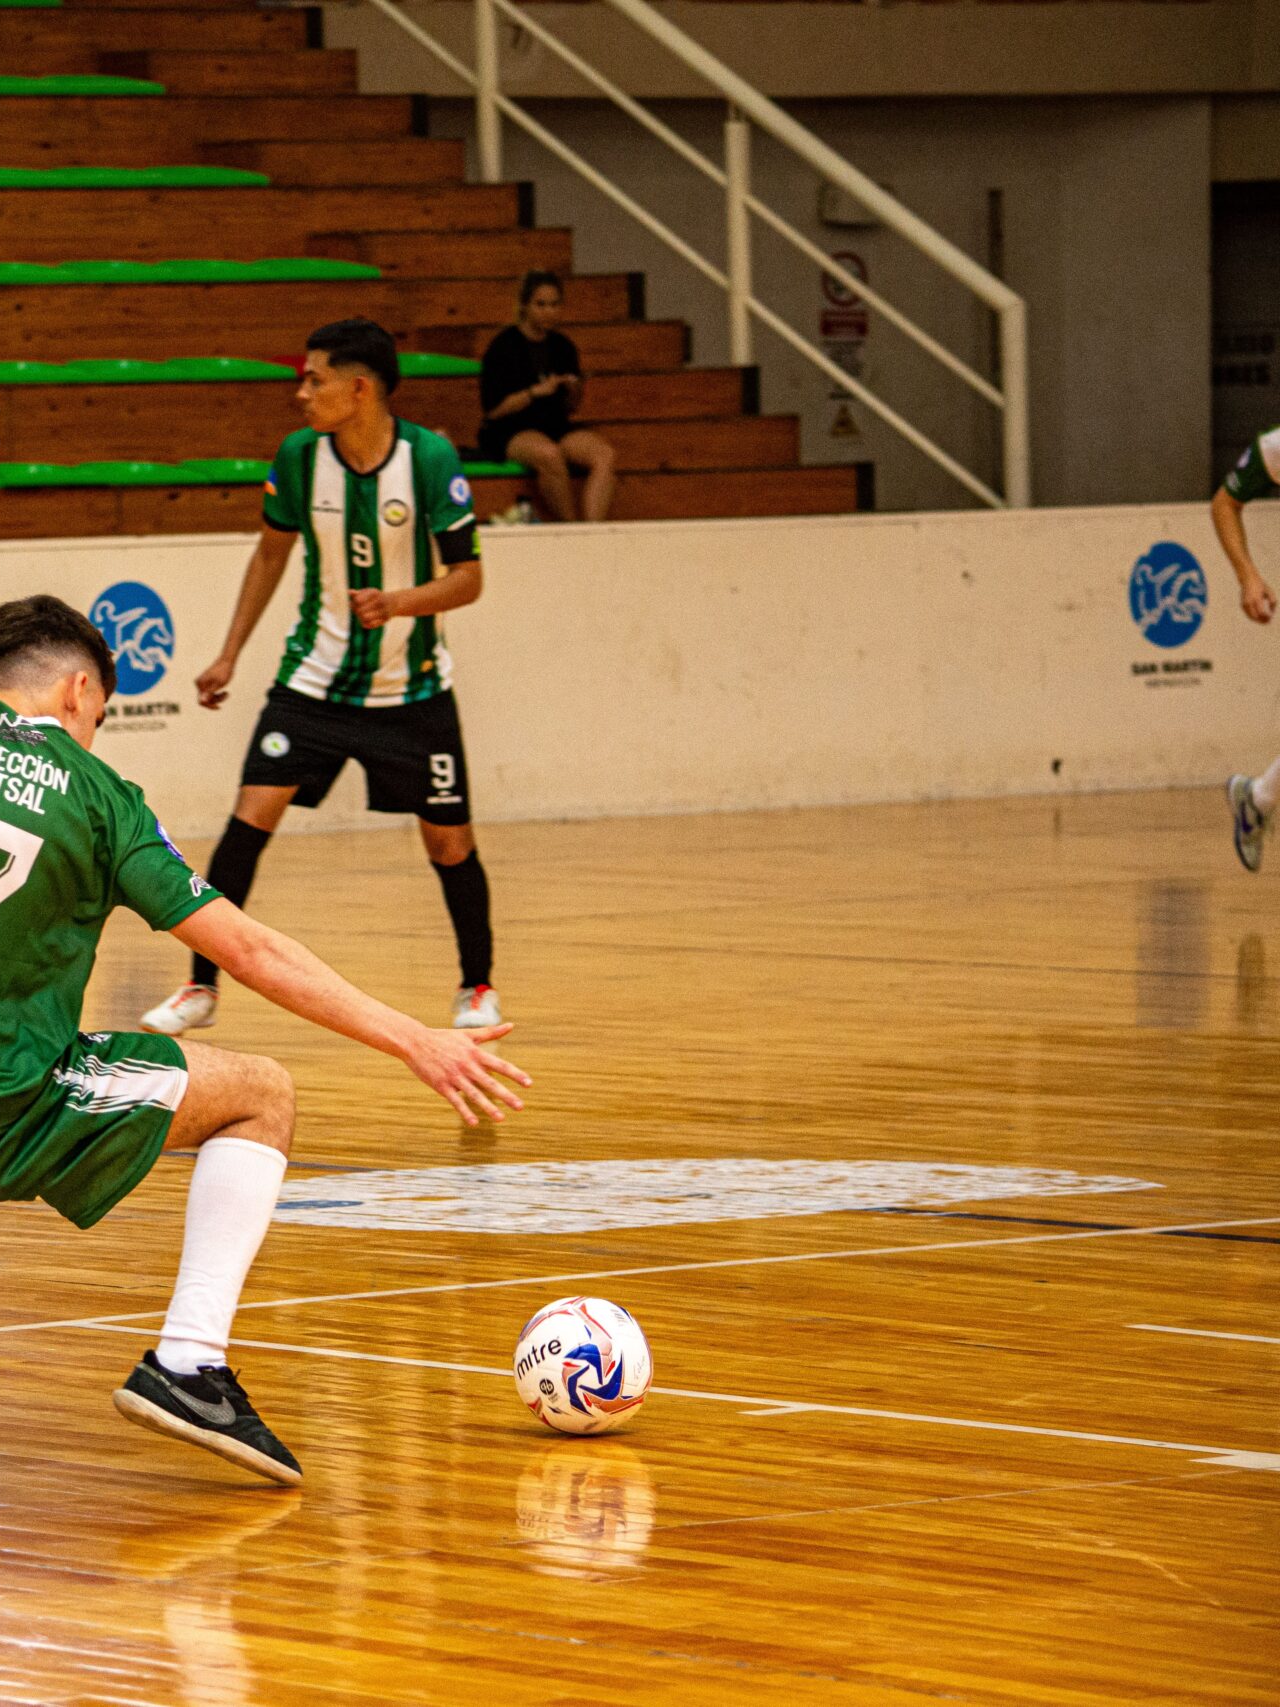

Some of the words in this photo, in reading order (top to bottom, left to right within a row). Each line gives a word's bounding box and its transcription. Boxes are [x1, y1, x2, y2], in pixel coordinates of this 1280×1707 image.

[352, 534, 374, 568] 9
[430, 753, 455, 789] 9
[516, 1339, 562, 1380] mitre
